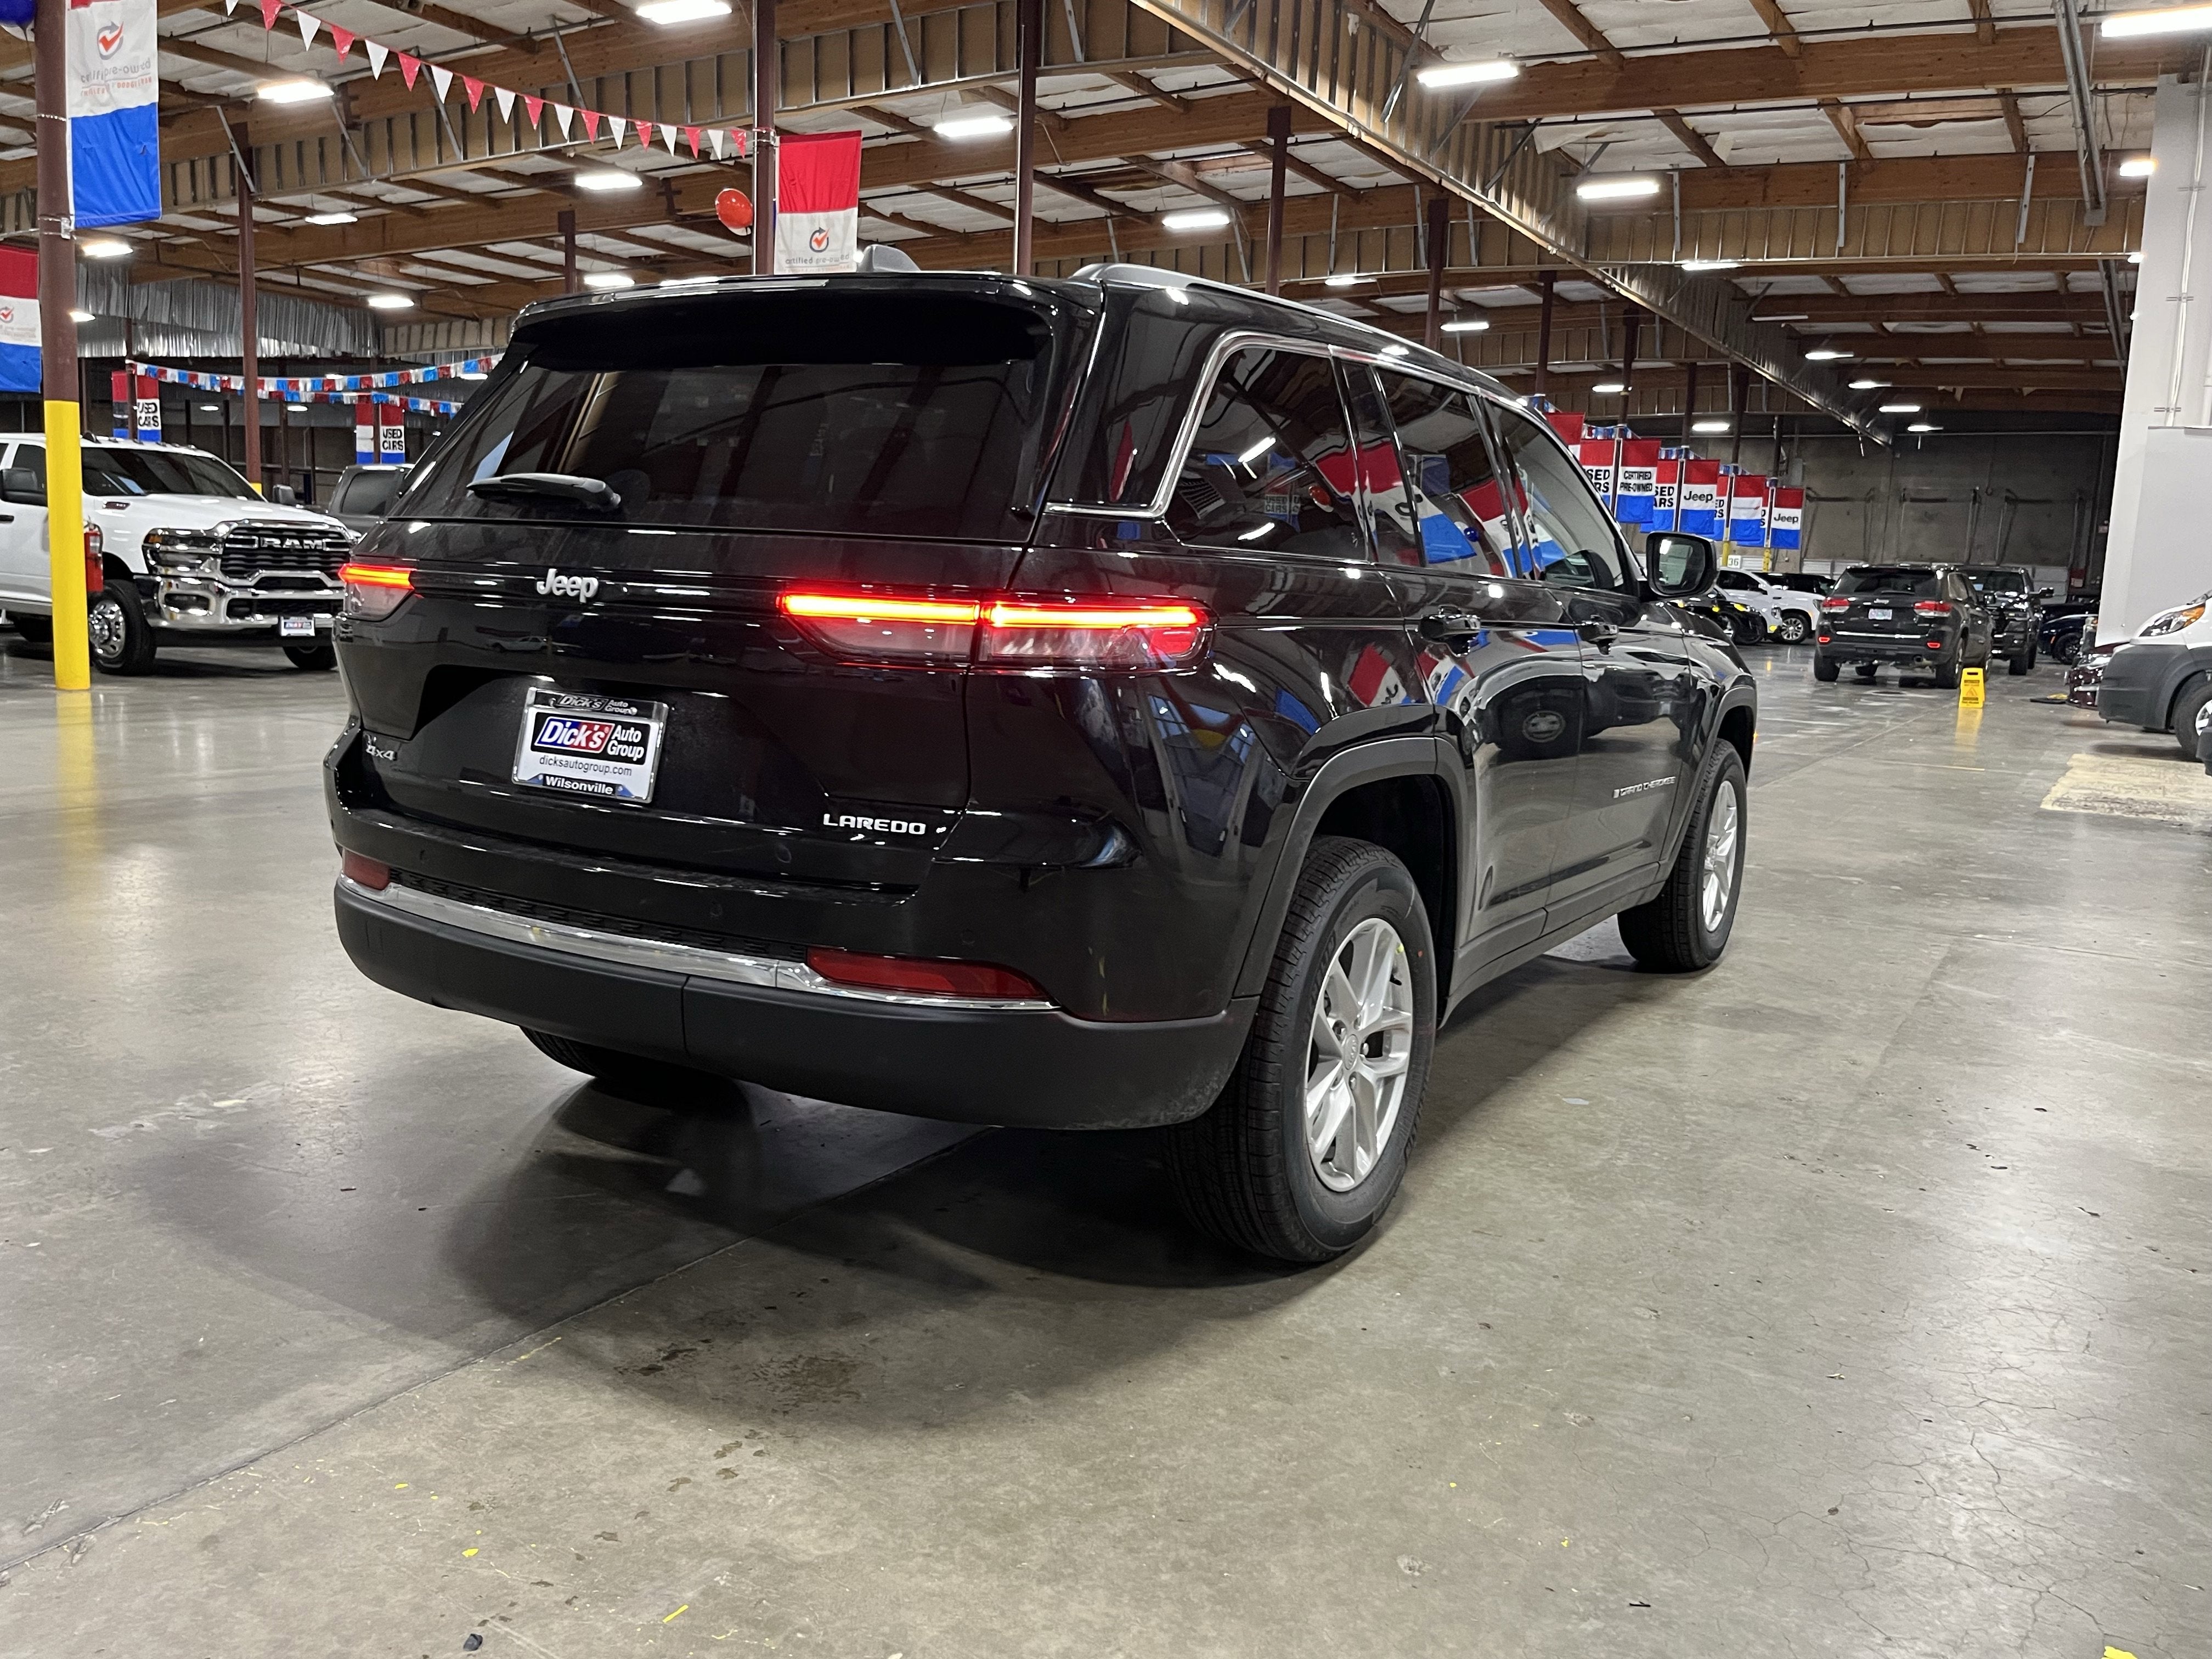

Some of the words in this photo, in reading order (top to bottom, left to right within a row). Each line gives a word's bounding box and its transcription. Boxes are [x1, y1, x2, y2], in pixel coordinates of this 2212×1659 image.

[382, 428, 403, 439] USED
[1583, 469, 1610, 481] SED
[1620, 482, 1653, 492] PRE-OWNED
[1683, 490, 1713, 503] Jeep
[1774, 513, 1799, 524] Jeep
[260, 537, 323, 549] RAM
[1728, 557, 1739, 566] 36
[537, 568, 599, 603] Jeep
[560, 695, 602, 709] Dick's
[540, 721, 605, 749] Dick's
[611, 725, 642, 743] Auto
[365, 744, 394, 760] 4x4
[607, 741, 645, 761] Group
[539, 755, 632, 776] dicksautogroup.com
[545, 775, 613, 795] Wilsonville
[823, 813, 926, 835] LAREDO
